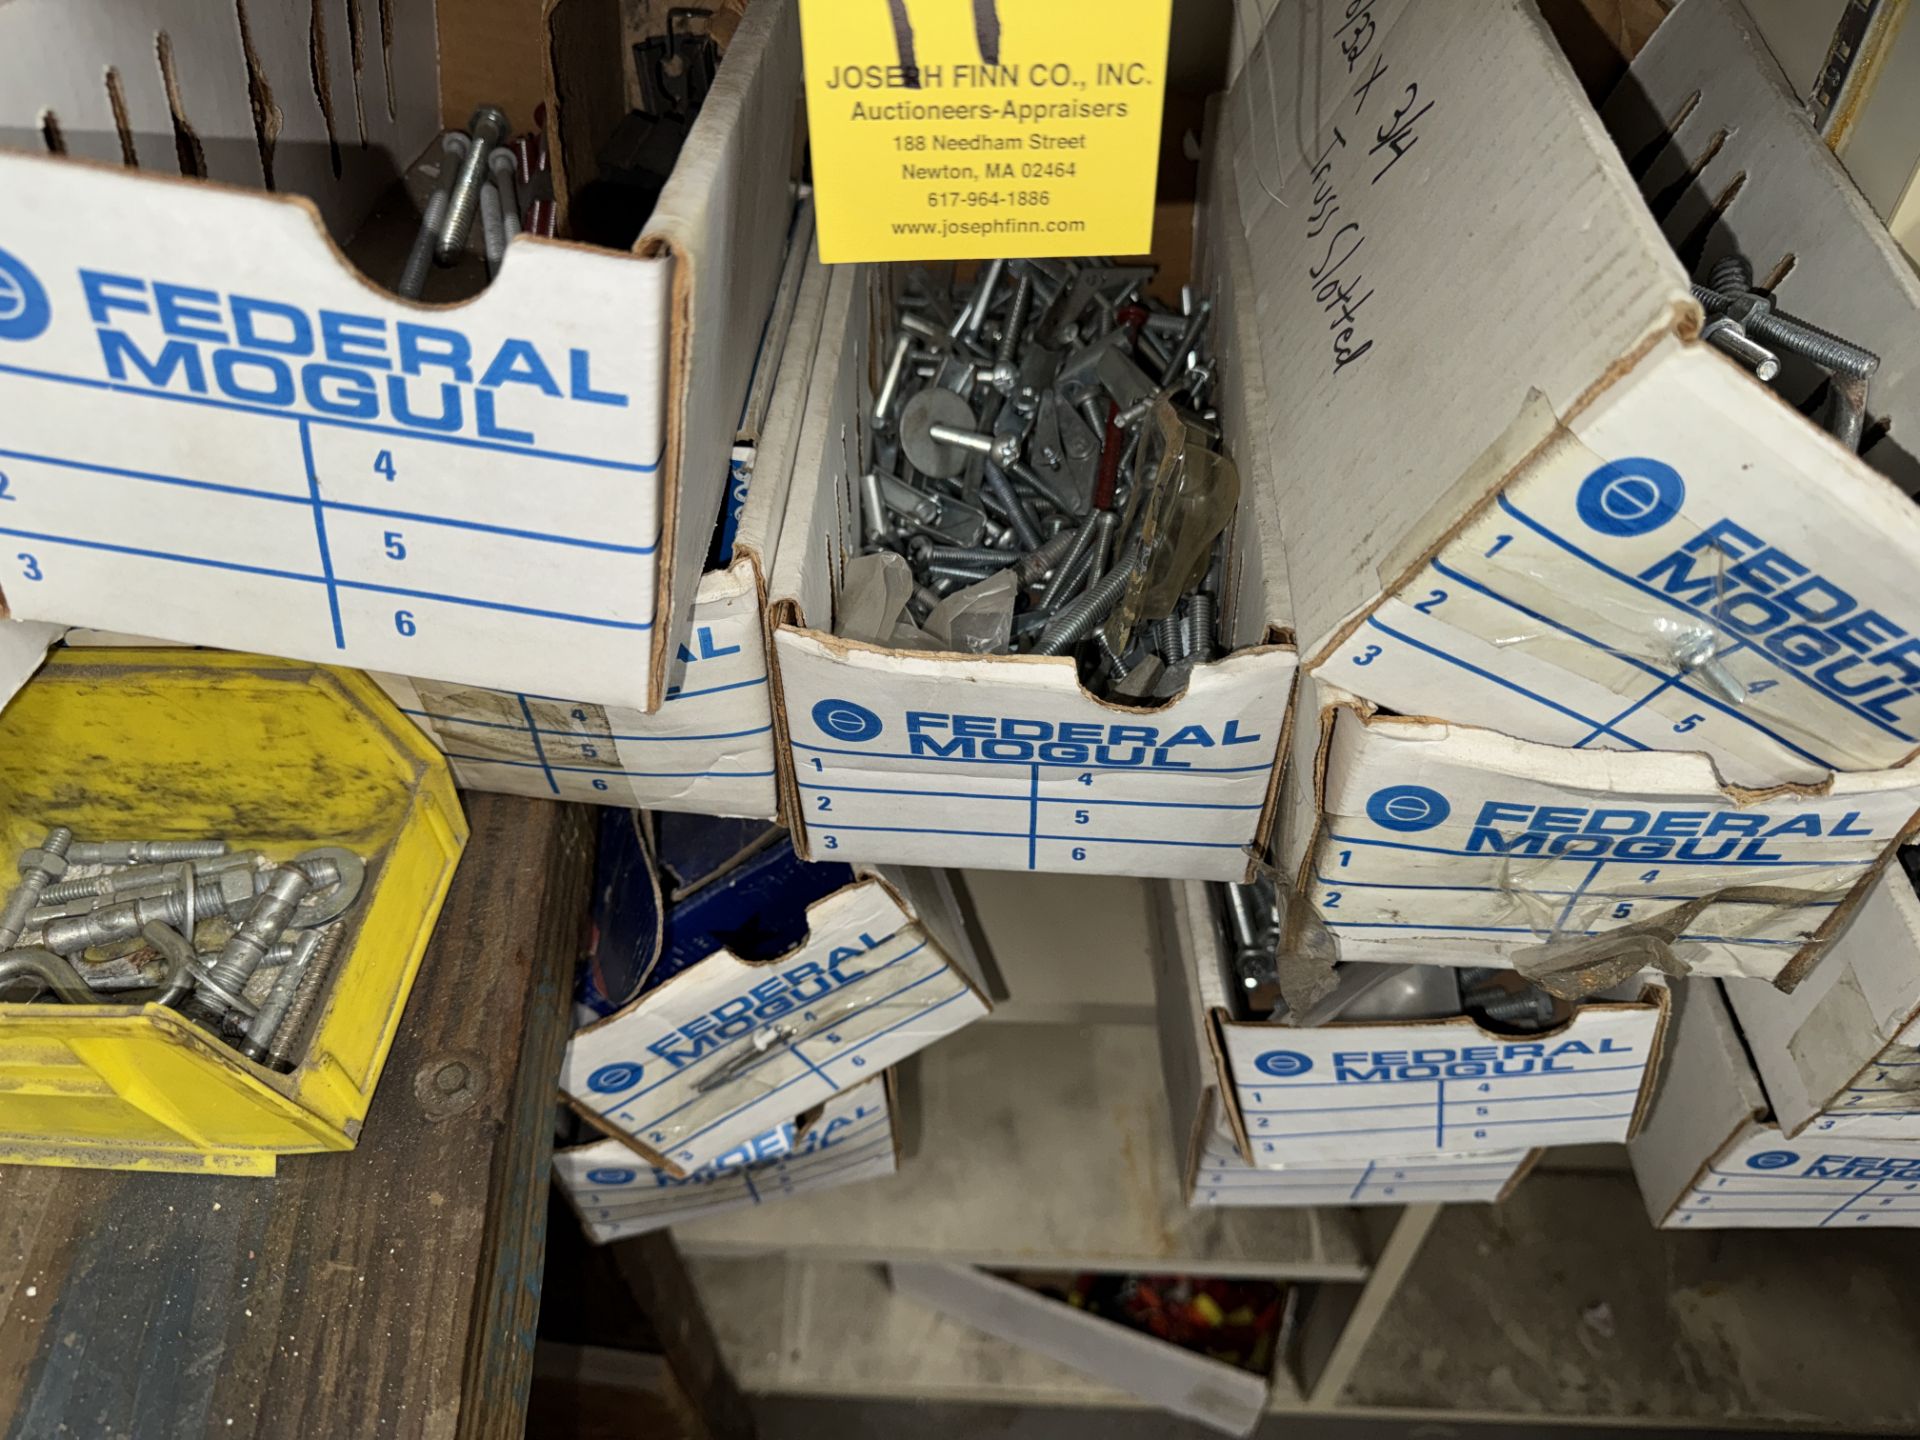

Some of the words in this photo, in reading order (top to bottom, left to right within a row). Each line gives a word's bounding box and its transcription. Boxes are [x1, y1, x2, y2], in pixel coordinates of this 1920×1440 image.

[953, 63, 1018, 89] FINN
[1028, 63, 1087, 90] CO.,
[1096, 62, 1152, 87] INC.
[851, 99, 1128, 123] Auctioneers-Appraisers
[893, 135, 926, 152] 188
[932, 134, 1023, 152] Needham
[1029, 133, 1086, 150] Street
[1369, 82, 1435, 185] 3/4
[901, 163, 979, 182] Newton,
[985, 163, 1015, 179] MA
[1021, 161, 1077, 178] 02464
[927, 190, 1050, 208] 617-964-1886
[891, 219, 1086, 237] www.josephfinn.com
[78, 268, 630, 408] FEDERAL
[96, 328, 535, 445] MOGUL
[373, 449, 397, 482] 4
[383, 531, 407, 561] 5
[1484, 534, 1514, 558] 1
[17, 552, 44, 582] 3
[1413, 589, 1448, 615] 2
[394, 610, 417, 637] 6
[1637, 549, 1915, 724] MOGUL
[1351, 644, 1383, 666] 3
[1747, 679, 1779, 694] 4
[570, 708, 588, 723] 4
[905, 710, 1261, 748] FEDERAL
[1672, 713, 1706, 734] 5
[581, 743, 598, 760] 5
[909, 733, 1192, 767] MOGUL
[591, 778, 609, 793] 6
[811, 757, 824, 773] 1
[1077, 772, 1093, 787] 4
[816, 796, 833, 813] 2
[1074, 809, 1090, 825] 5
[1474, 801, 1875, 838] FEDERAL
[822, 835, 839, 851] 3
[1071, 846, 1087, 862] 6
[1464, 826, 1783, 861] MOGUL
[1338, 850, 1353, 868] 1
[1639, 869, 1660, 884] 4
[1322, 891, 1342, 909] 2
[1612, 902, 1634, 920] 5
[646, 932, 896, 1058] FEDERAL
[661, 967, 866, 1069] MOGUL
[851, 1055, 866, 1067] 6
[1332, 1038, 1634, 1067] FEDERAL
[1335, 1057, 1576, 1082] MOGUL
[1476, 1081, 1491, 1093] 4
[1844, 1095, 1864, 1107] 2
[1257, 1116, 1270, 1129] 2
[1817, 1120, 1836, 1131] 3
[649, 1131, 666, 1144] 2
